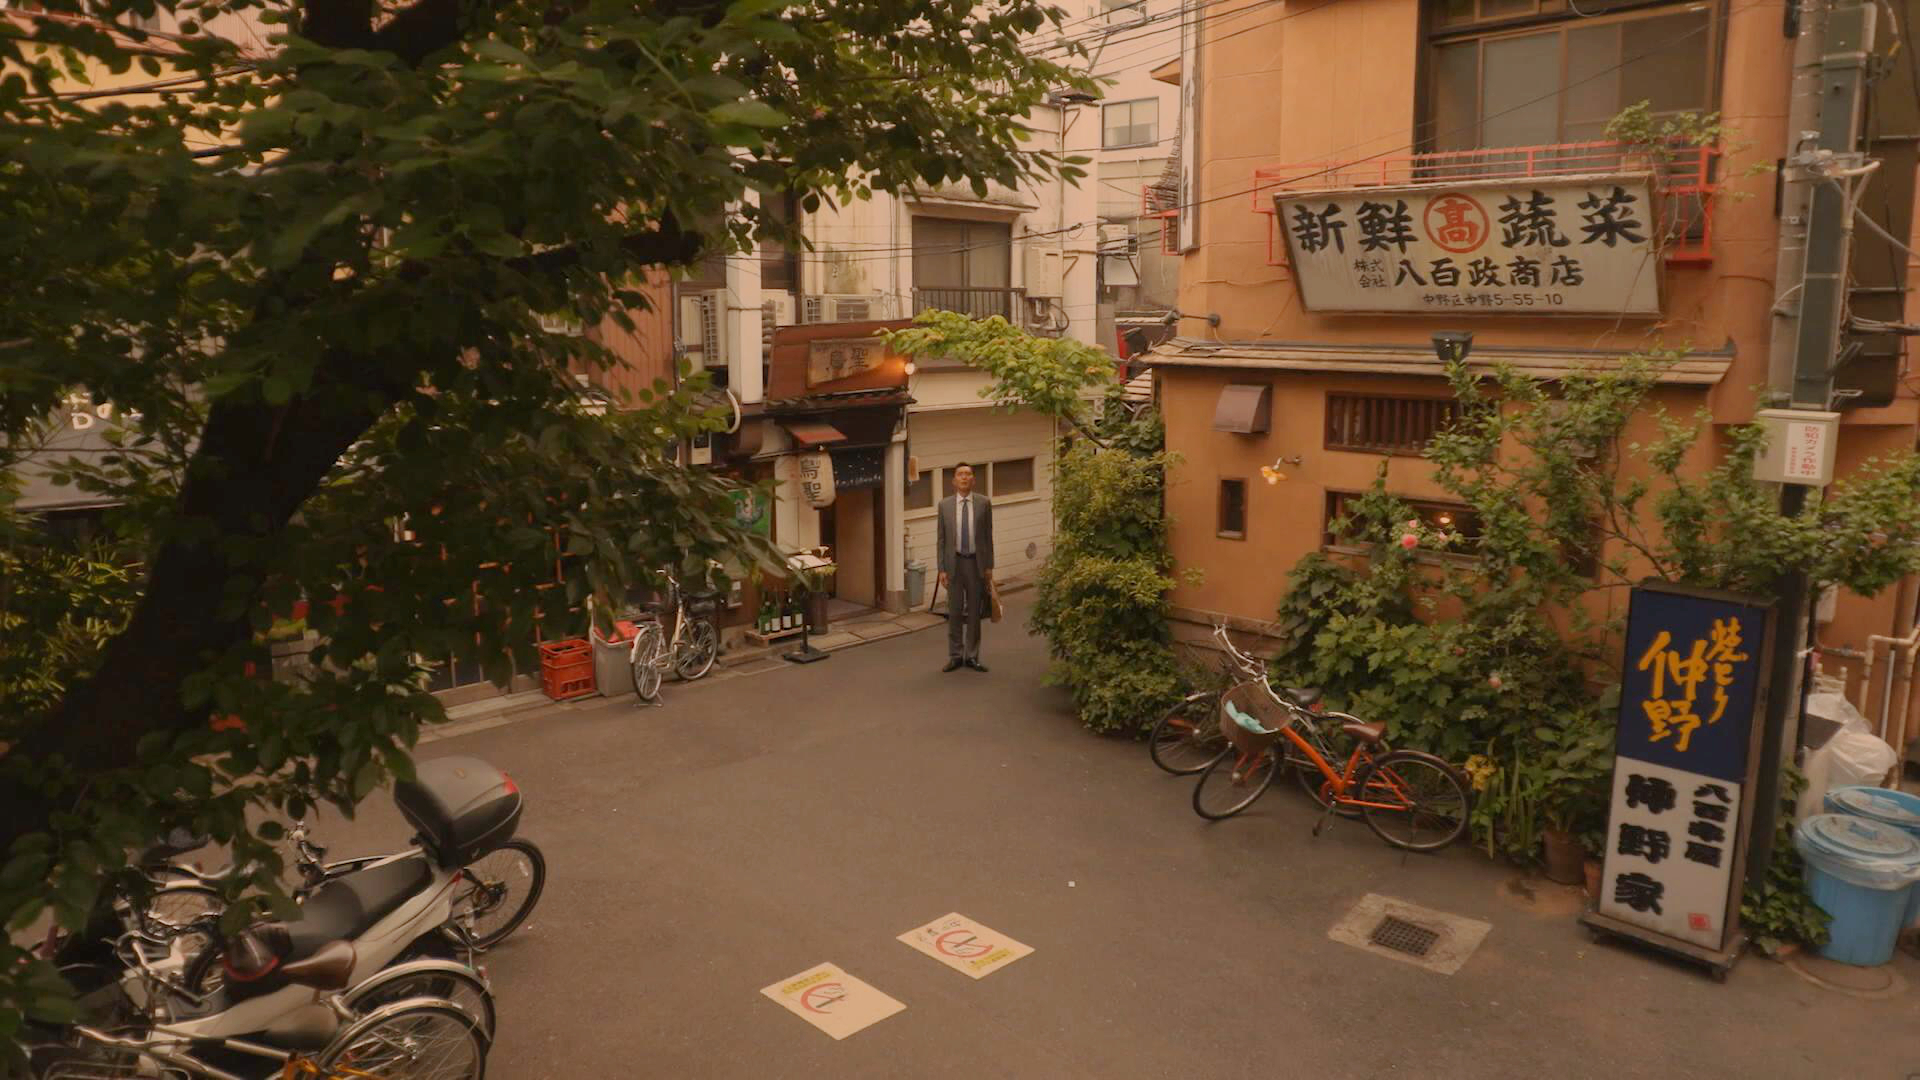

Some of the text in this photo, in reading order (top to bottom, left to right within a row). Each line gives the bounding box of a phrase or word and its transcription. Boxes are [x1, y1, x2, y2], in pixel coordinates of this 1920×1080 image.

[1292, 200, 1418, 254] 新鮮
[1353, 258, 1385, 273] 株式
[1359, 274, 1388, 289] 会社
[1395, 255, 1584, 288] 八百政商店
[1638, 630, 1709, 752] 仲野
[1705, 616, 1749, 725] 焼とり
